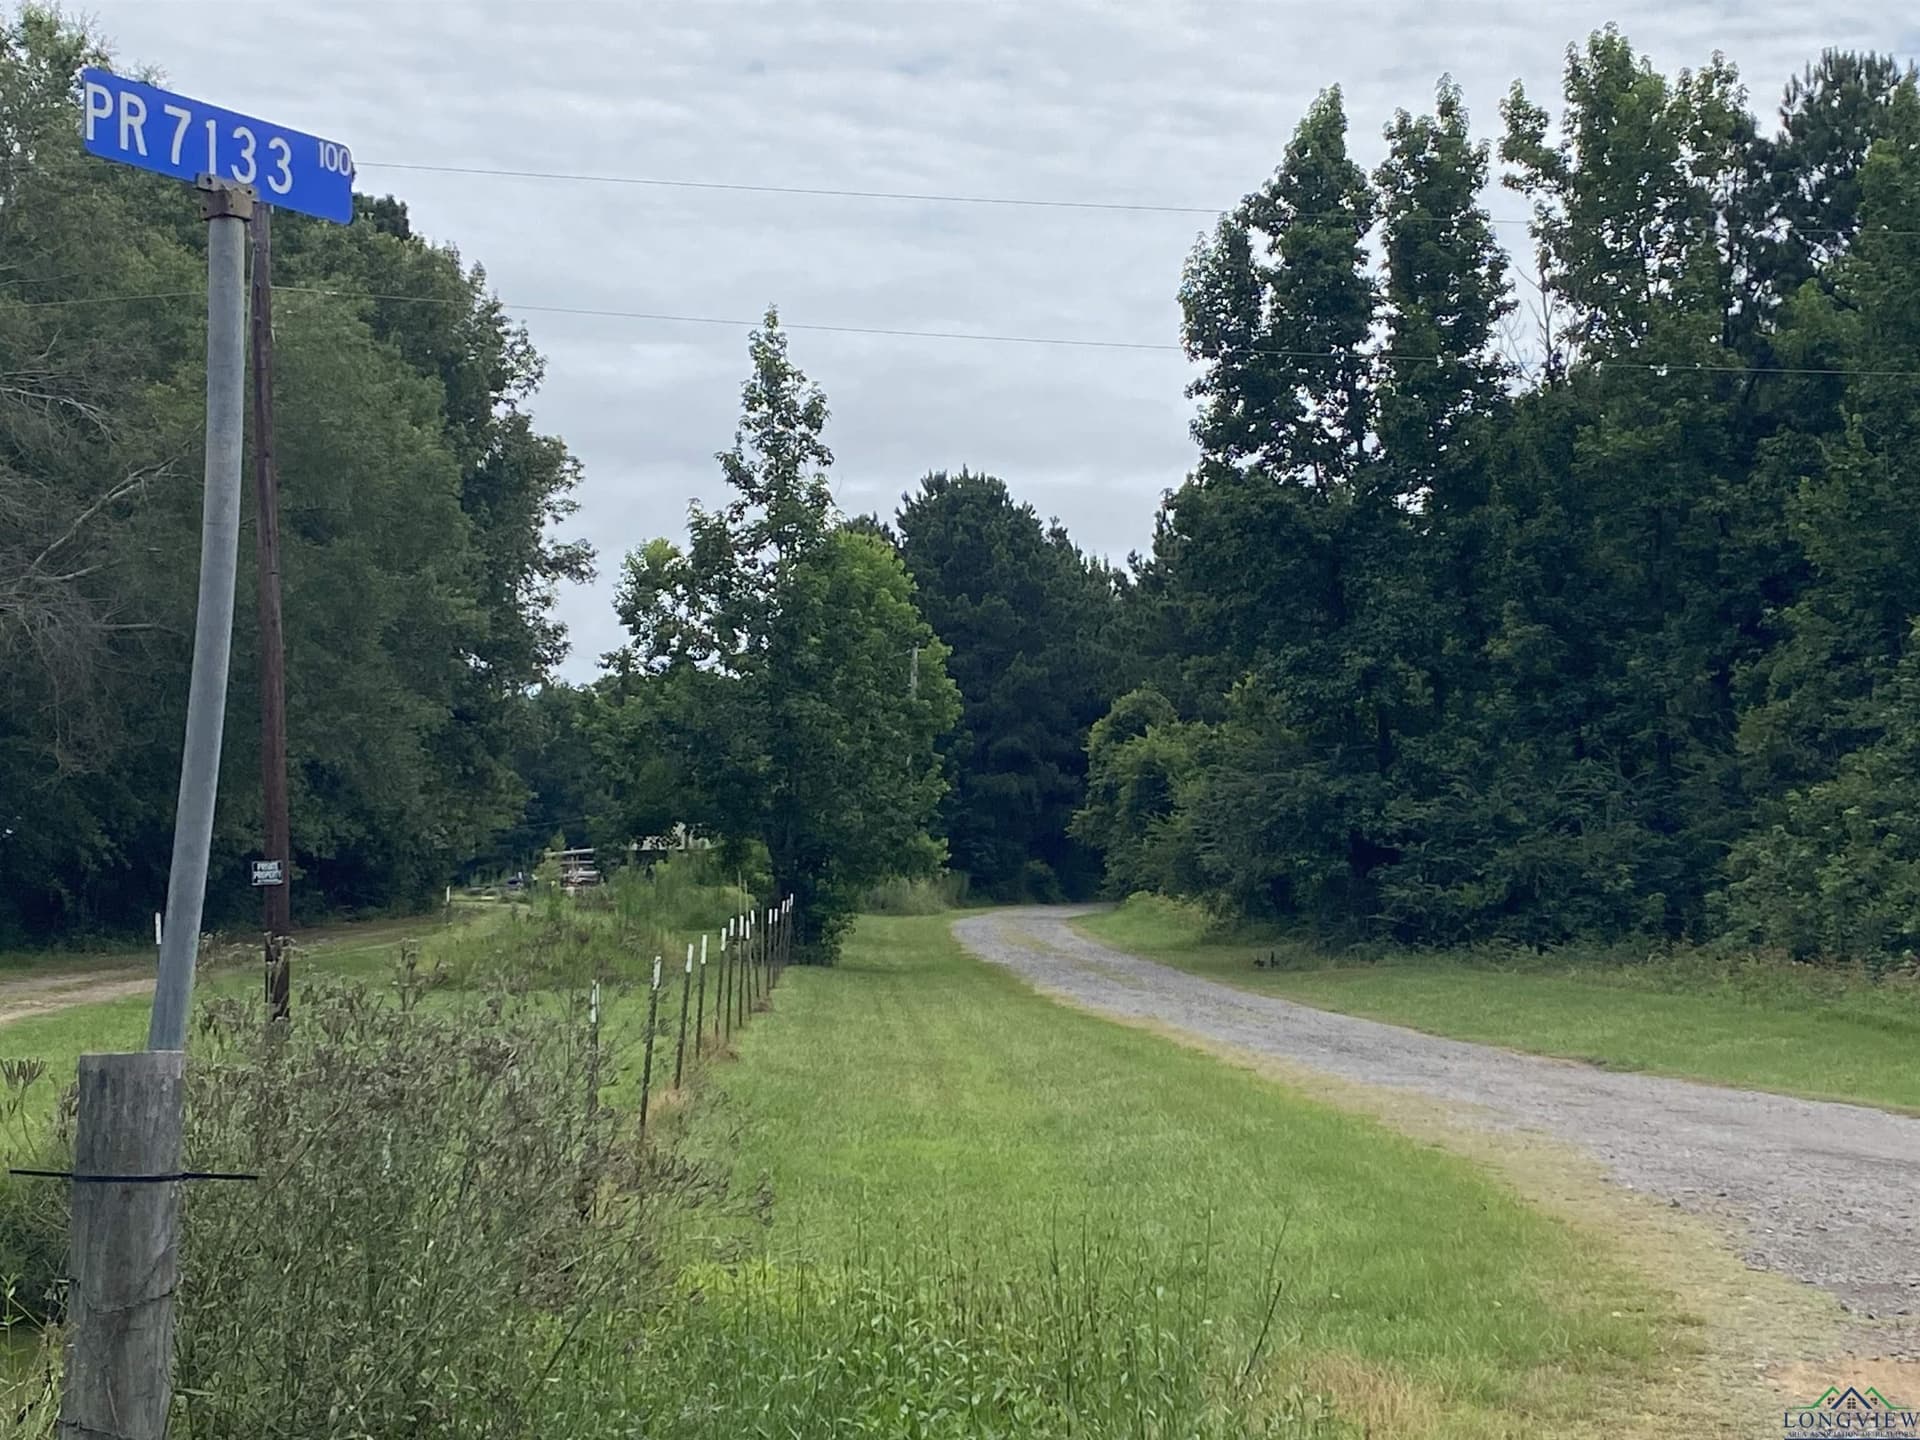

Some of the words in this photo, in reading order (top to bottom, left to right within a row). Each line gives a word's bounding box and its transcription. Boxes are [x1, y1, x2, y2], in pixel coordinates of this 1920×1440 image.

[85, 81, 148, 157] PR
[163, 104, 293, 195] 7133
[318, 140, 352, 177] 100
